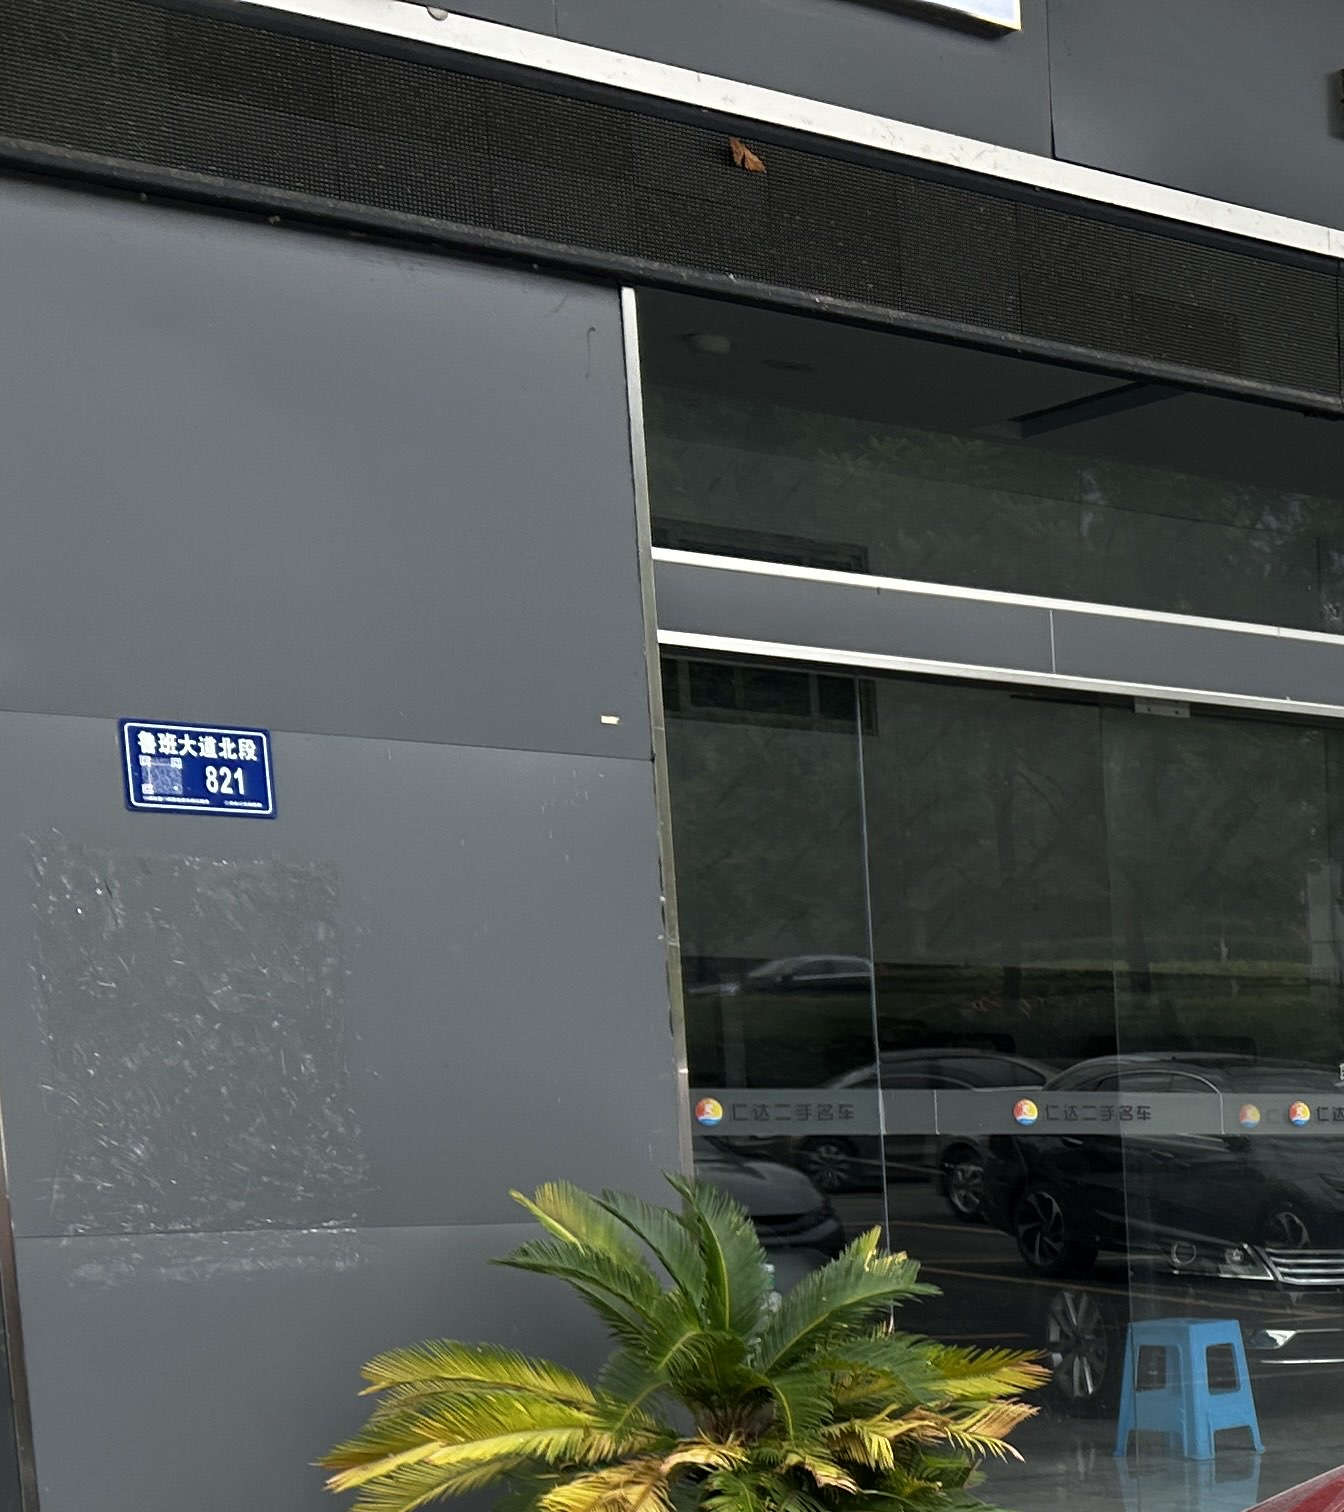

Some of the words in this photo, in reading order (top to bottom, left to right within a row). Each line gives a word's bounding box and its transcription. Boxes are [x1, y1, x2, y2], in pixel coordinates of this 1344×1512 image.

[138, 730, 258, 762] 鲁班大道北段
[205, 765, 245, 795] 821
[732, 1103, 855, 1122] 仁达二手名车
[1045, 1104, 1152, 1121] 仁达二手名车
